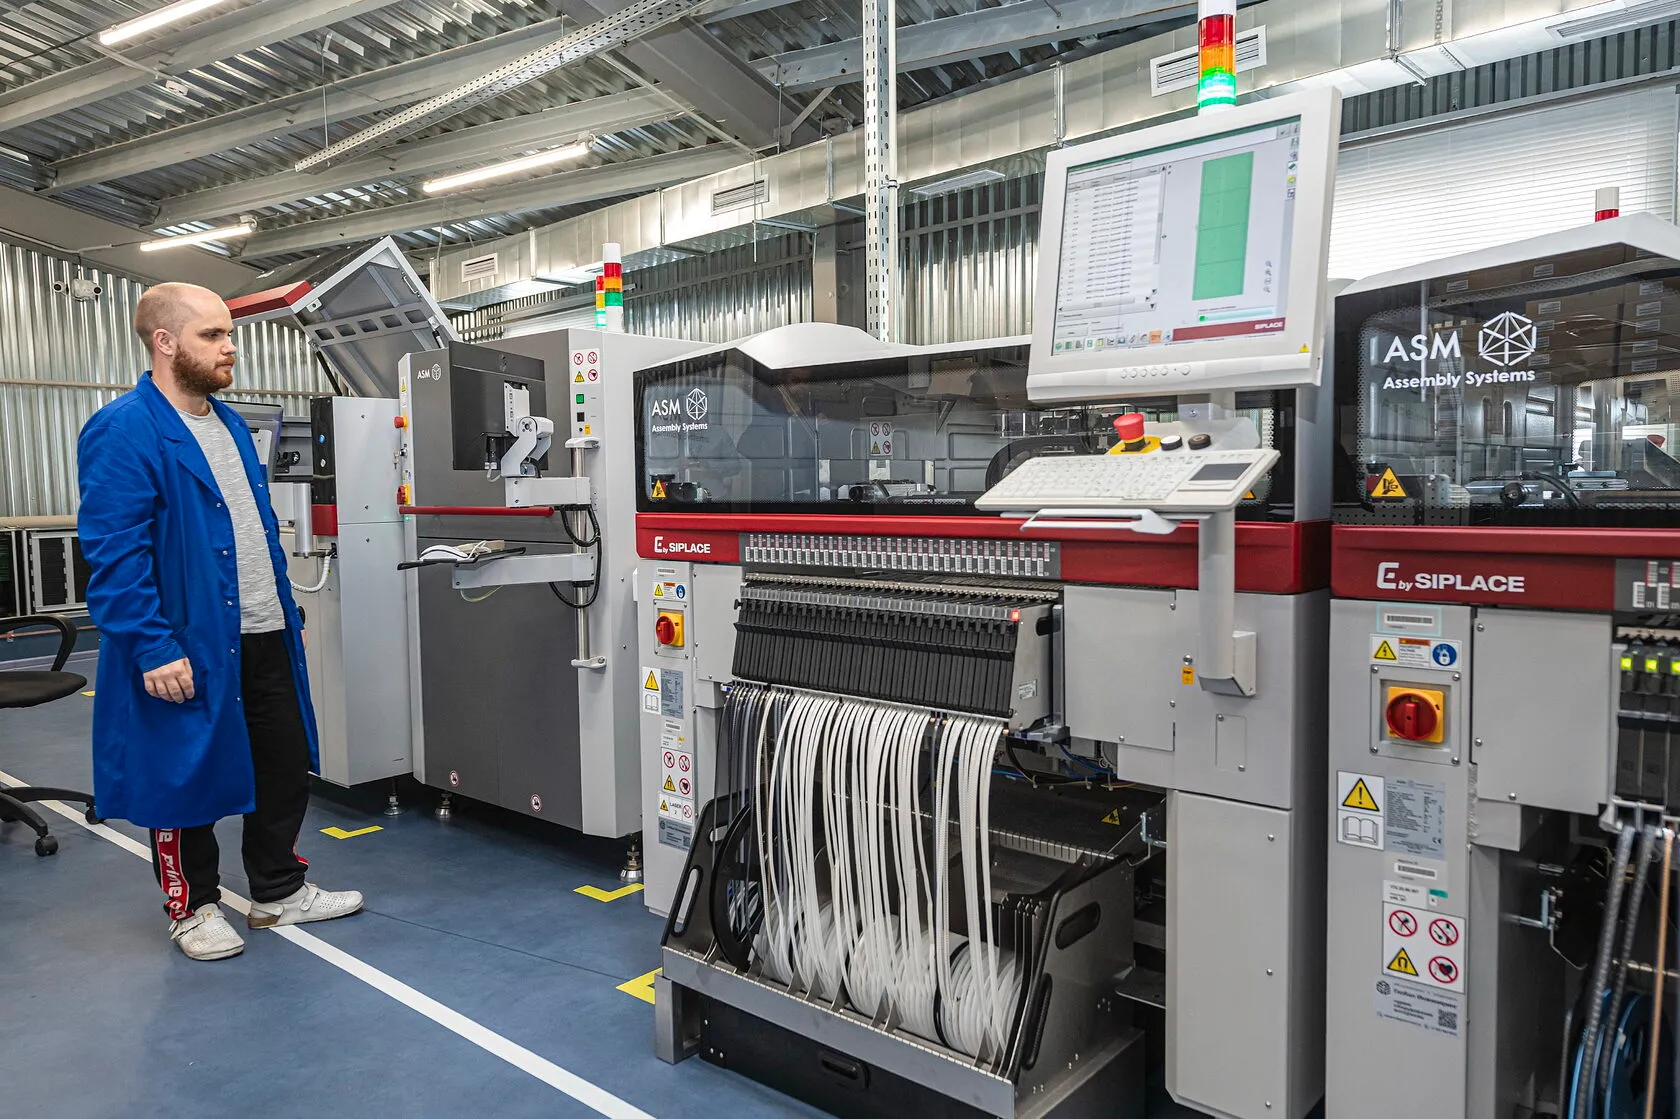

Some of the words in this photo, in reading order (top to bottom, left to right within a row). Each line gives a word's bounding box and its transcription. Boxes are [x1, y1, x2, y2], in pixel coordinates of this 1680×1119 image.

[1254, 321, 1284, 330] SIPLACE
[1383, 330, 1461, 362] ASM
[417, 369, 431, 379] ASM
[1383, 372, 1461, 389] Assembly
[1465, 369, 1535, 387] Systems
[651, 398, 681, 416] ASM
[651, 423, 681, 433] Assembly
[682, 422, 708, 432] Systems
[654, 536, 663, 553] E
[669, 542, 711, 554] SIPLACE
[1376, 561, 1400, 589] E
[1398, 580, 1413, 592] by
[1414, 572, 1525, 593] SIPLACE
